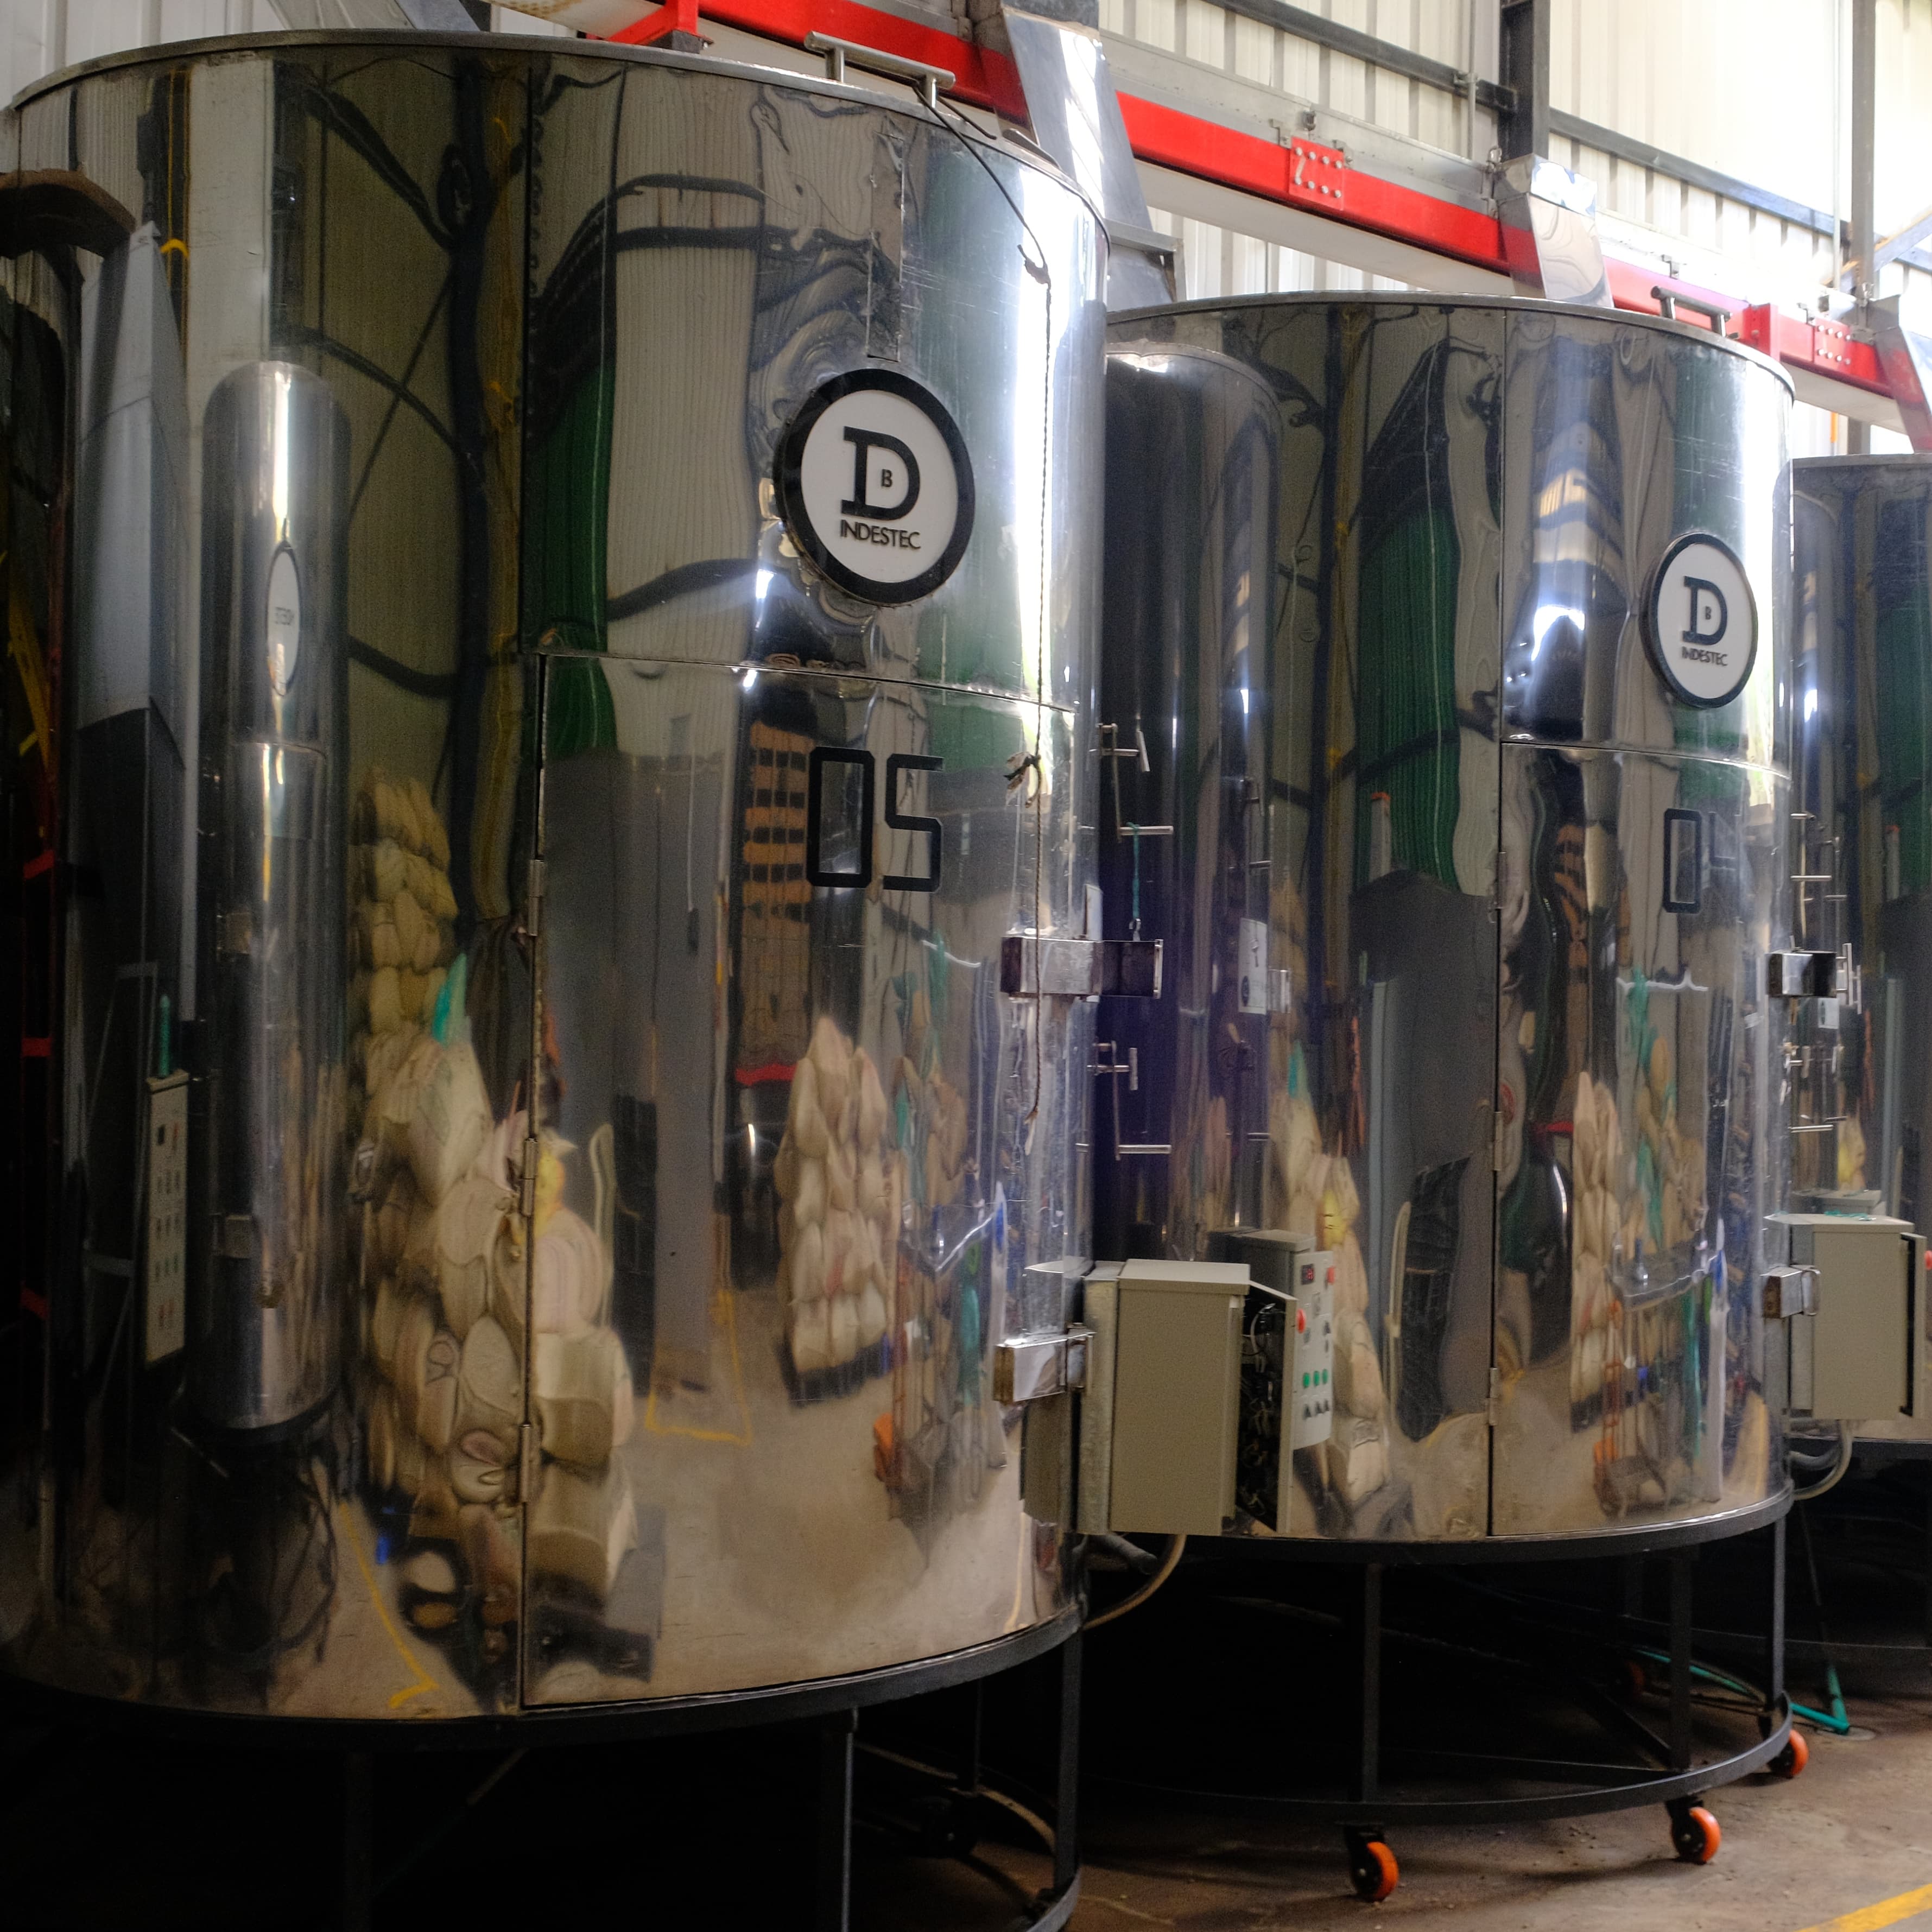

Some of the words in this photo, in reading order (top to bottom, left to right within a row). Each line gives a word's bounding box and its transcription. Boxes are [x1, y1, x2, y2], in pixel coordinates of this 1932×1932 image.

[841, 426, 920, 521] D
[881, 468, 893, 487] B
[840, 519, 921, 550] INDESTEC
[1682, 575, 1728, 645] D
[1681, 646, 1728, 667] INDESTEC
[806, 746, 944, 892] 05
